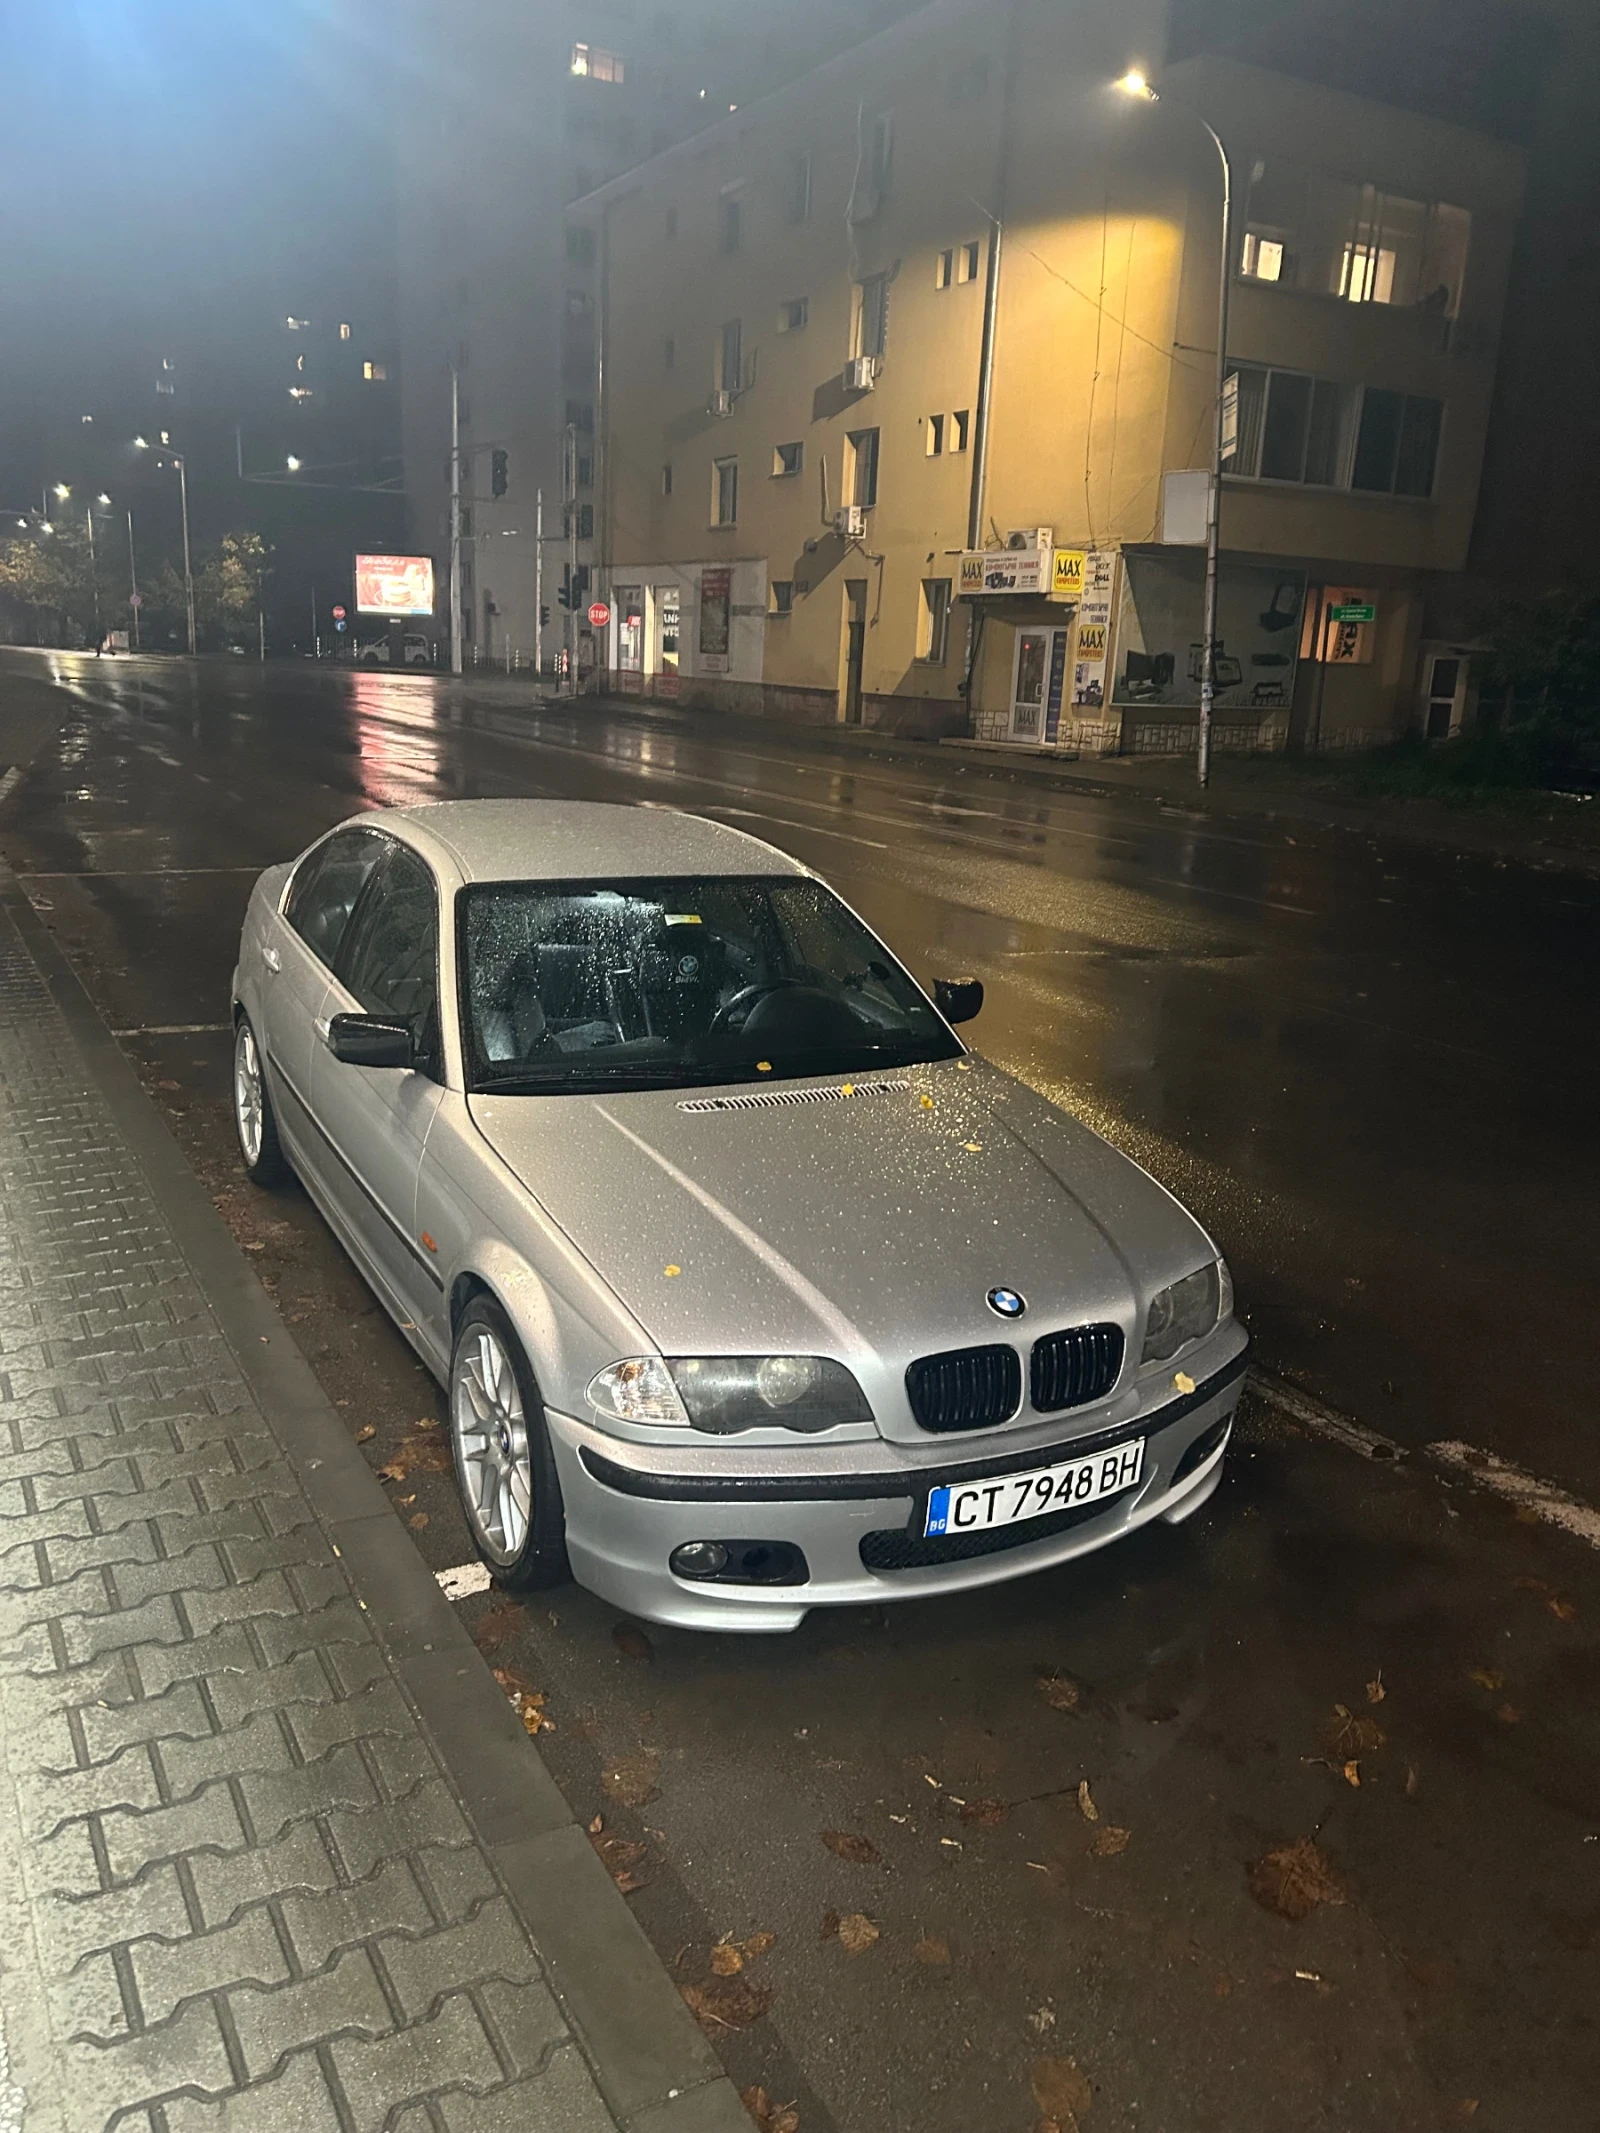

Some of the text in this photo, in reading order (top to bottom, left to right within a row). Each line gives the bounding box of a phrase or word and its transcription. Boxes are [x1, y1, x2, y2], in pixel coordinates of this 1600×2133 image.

[962, 561, 983, 579] MAX
[1057, 559, 1082, 578] MAX
[590, 609, 608, 620] STOP
[1079, 629, 1105, 649] MAX
[1018, 709, 1037, 726] MAX
[954, 1447, 1140, 1527] CT 7948 BH
[929, 1518, 946, 1532] BG
